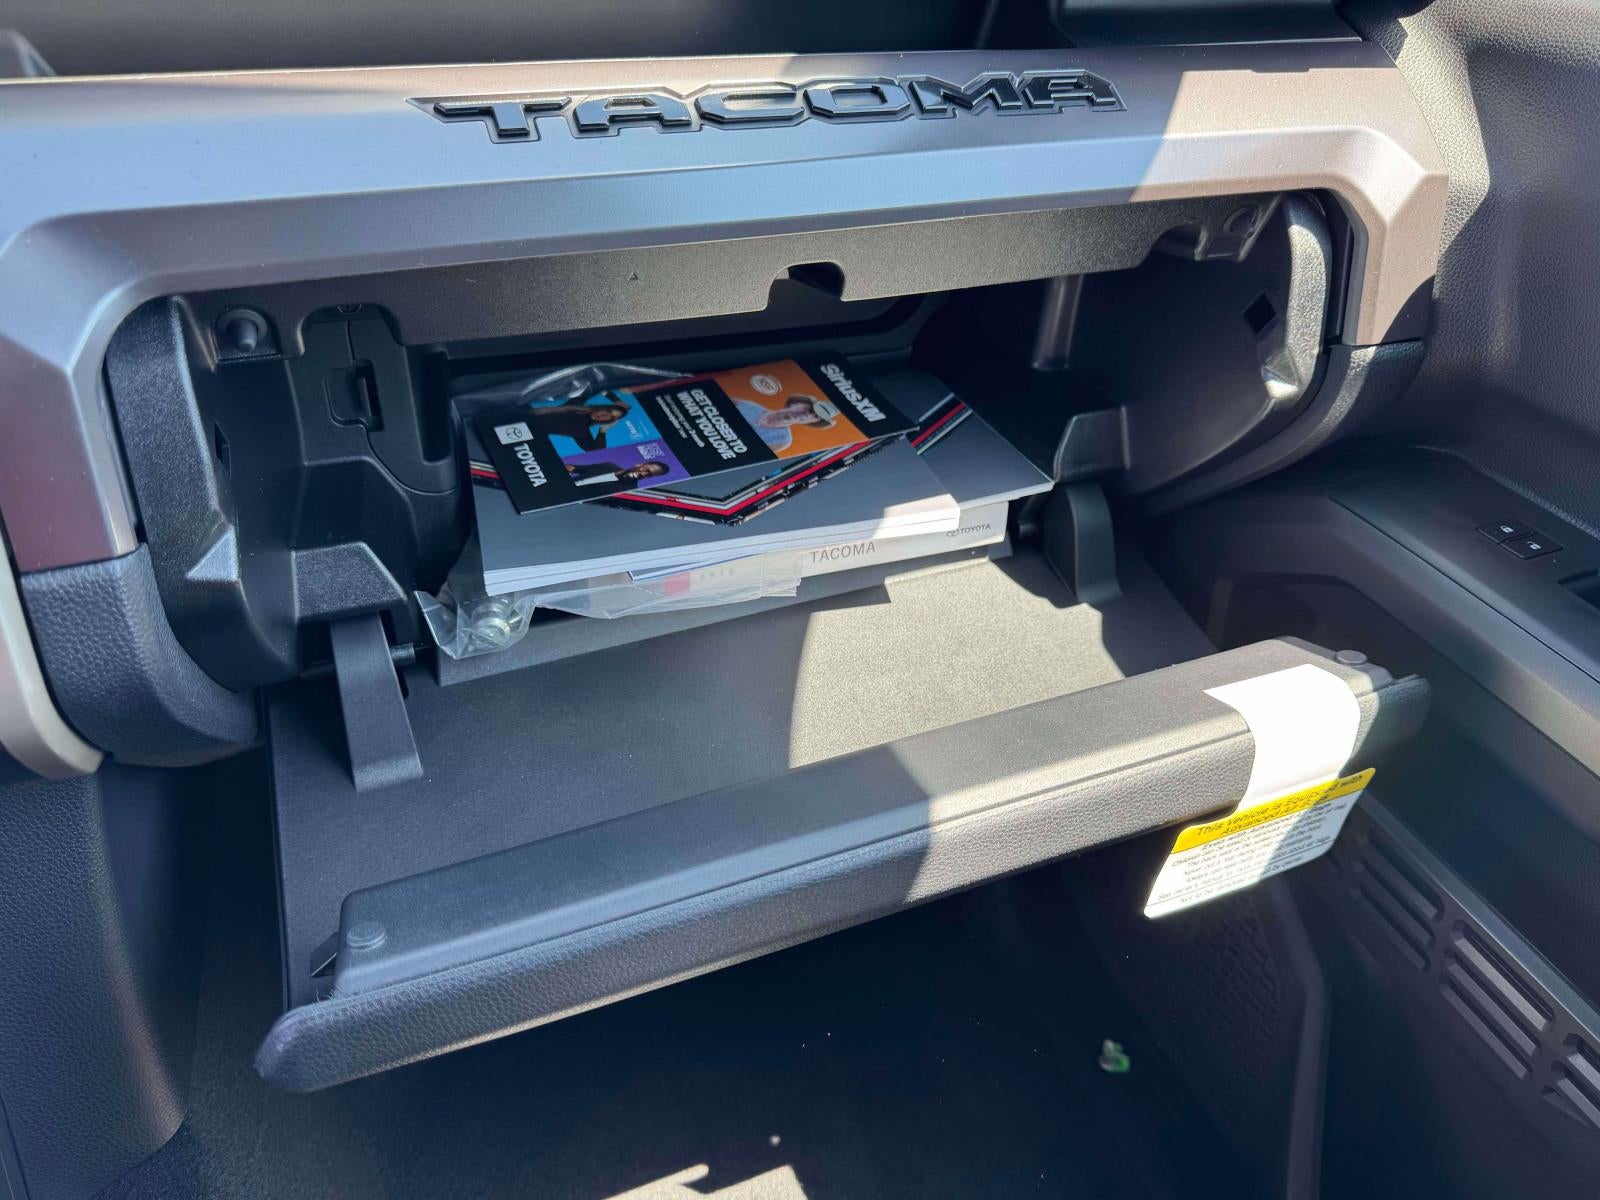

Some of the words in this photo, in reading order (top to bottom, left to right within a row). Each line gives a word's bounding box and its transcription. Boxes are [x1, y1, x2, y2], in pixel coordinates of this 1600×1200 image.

[412, 69, 1127, 144] TACOMA
[820, 363, 887, 422] SiriusXM
[676, 391, 704, 420] WHAT
[696, 416, 716, 440] YOU
[708, 434, 737, 460] LOVE
[689, 389, 714, 411] GET
[703, 403, 739, 442] CLOSER
[732, 438, 748, 453] TO
[513, 442, 548, 488] TOYOTA
[810, 541, 876, 563] TACOMA
[960, 523, 991, 535] TOYOTA
[1197, 822, 1223, 836] This
